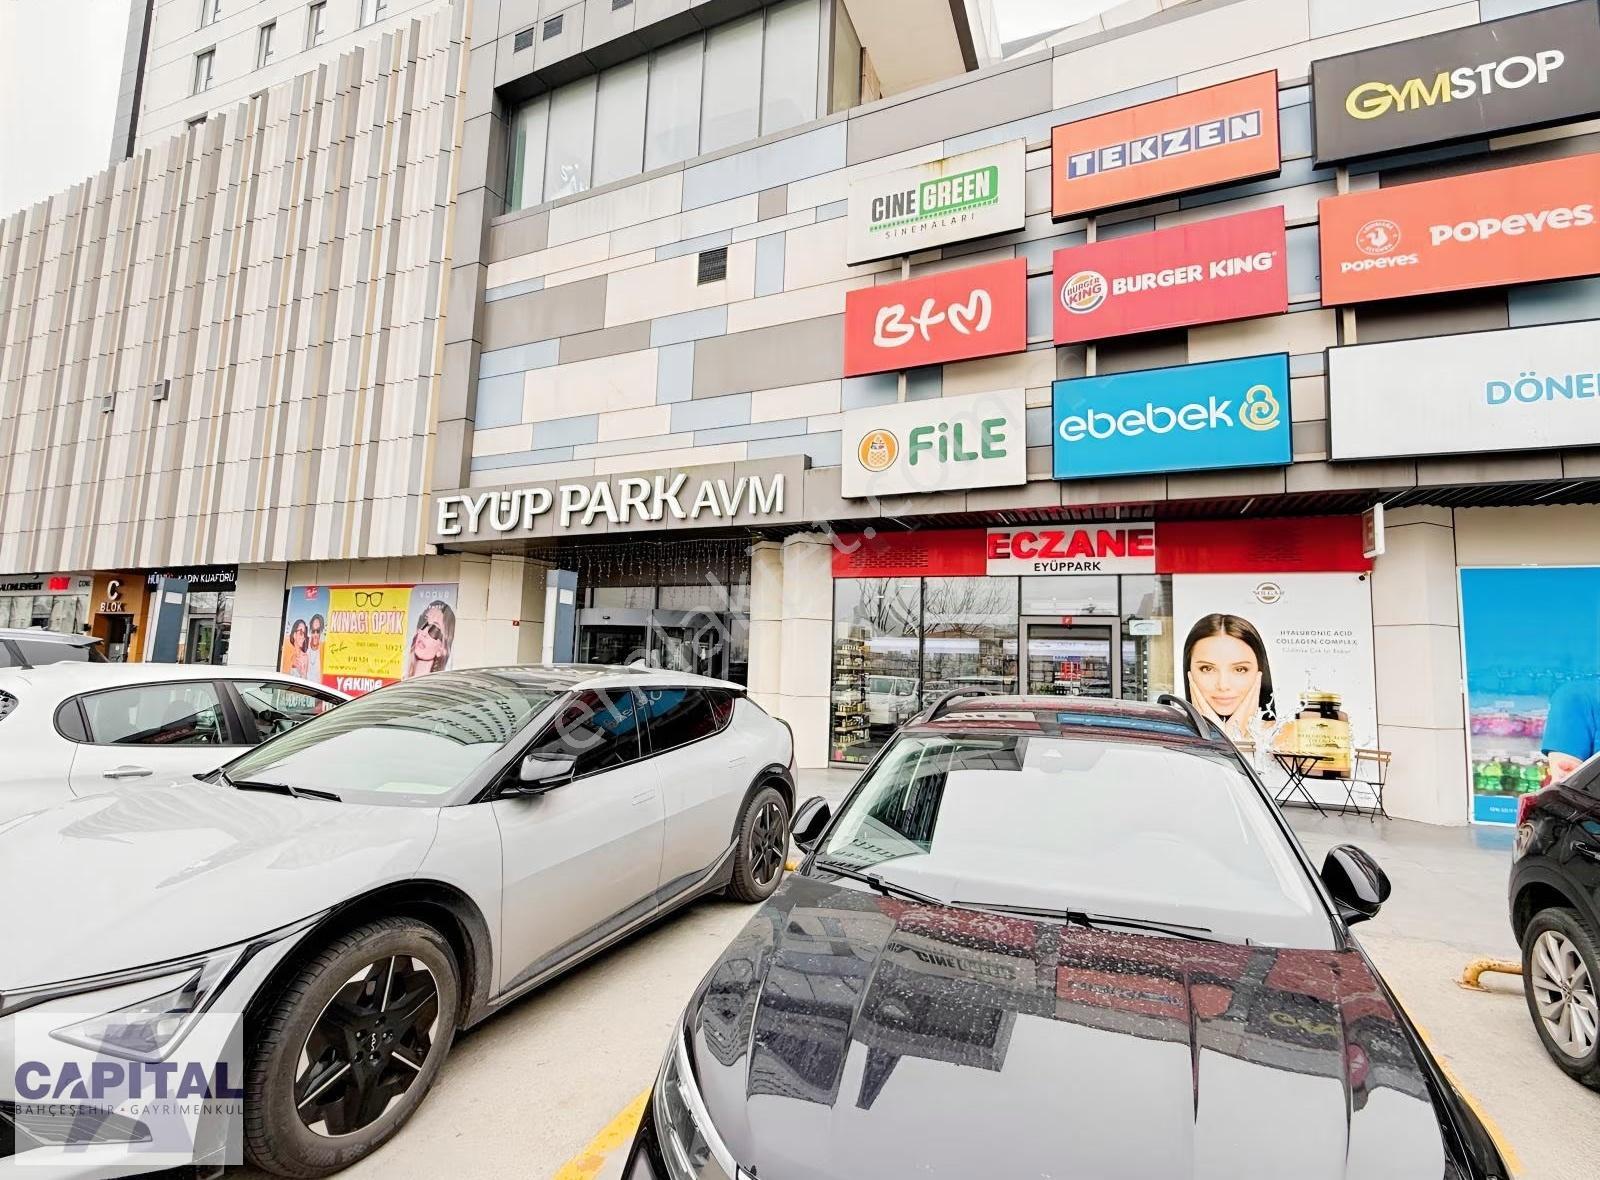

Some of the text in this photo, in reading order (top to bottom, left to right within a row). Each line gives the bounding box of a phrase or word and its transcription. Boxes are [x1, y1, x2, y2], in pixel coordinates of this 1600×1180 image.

[1345, 49, 1565, 120] GYMSTOP
[1069, 112, 1261, 178] TEKZEN
[871, 170, 991, 222] CINE GREEN
[1067, 277, 1100, 297] BURGER
[1069, 283, 1102, 304] KING
[1112, 265, 1203, 296] BURGER
[1486, 371, 1600, 405] DÖNE
[1059, 395, 1234, 442] ebebek
[437, 472, 786, 535] EYÜP PARK AVM
[986, 528, 1156, 560] ECZANE
[1033, 560, 1102, 572] EYÜPPARK
[107, 580, 120, 601] C
[100, 602, 122, 612] BLOK
